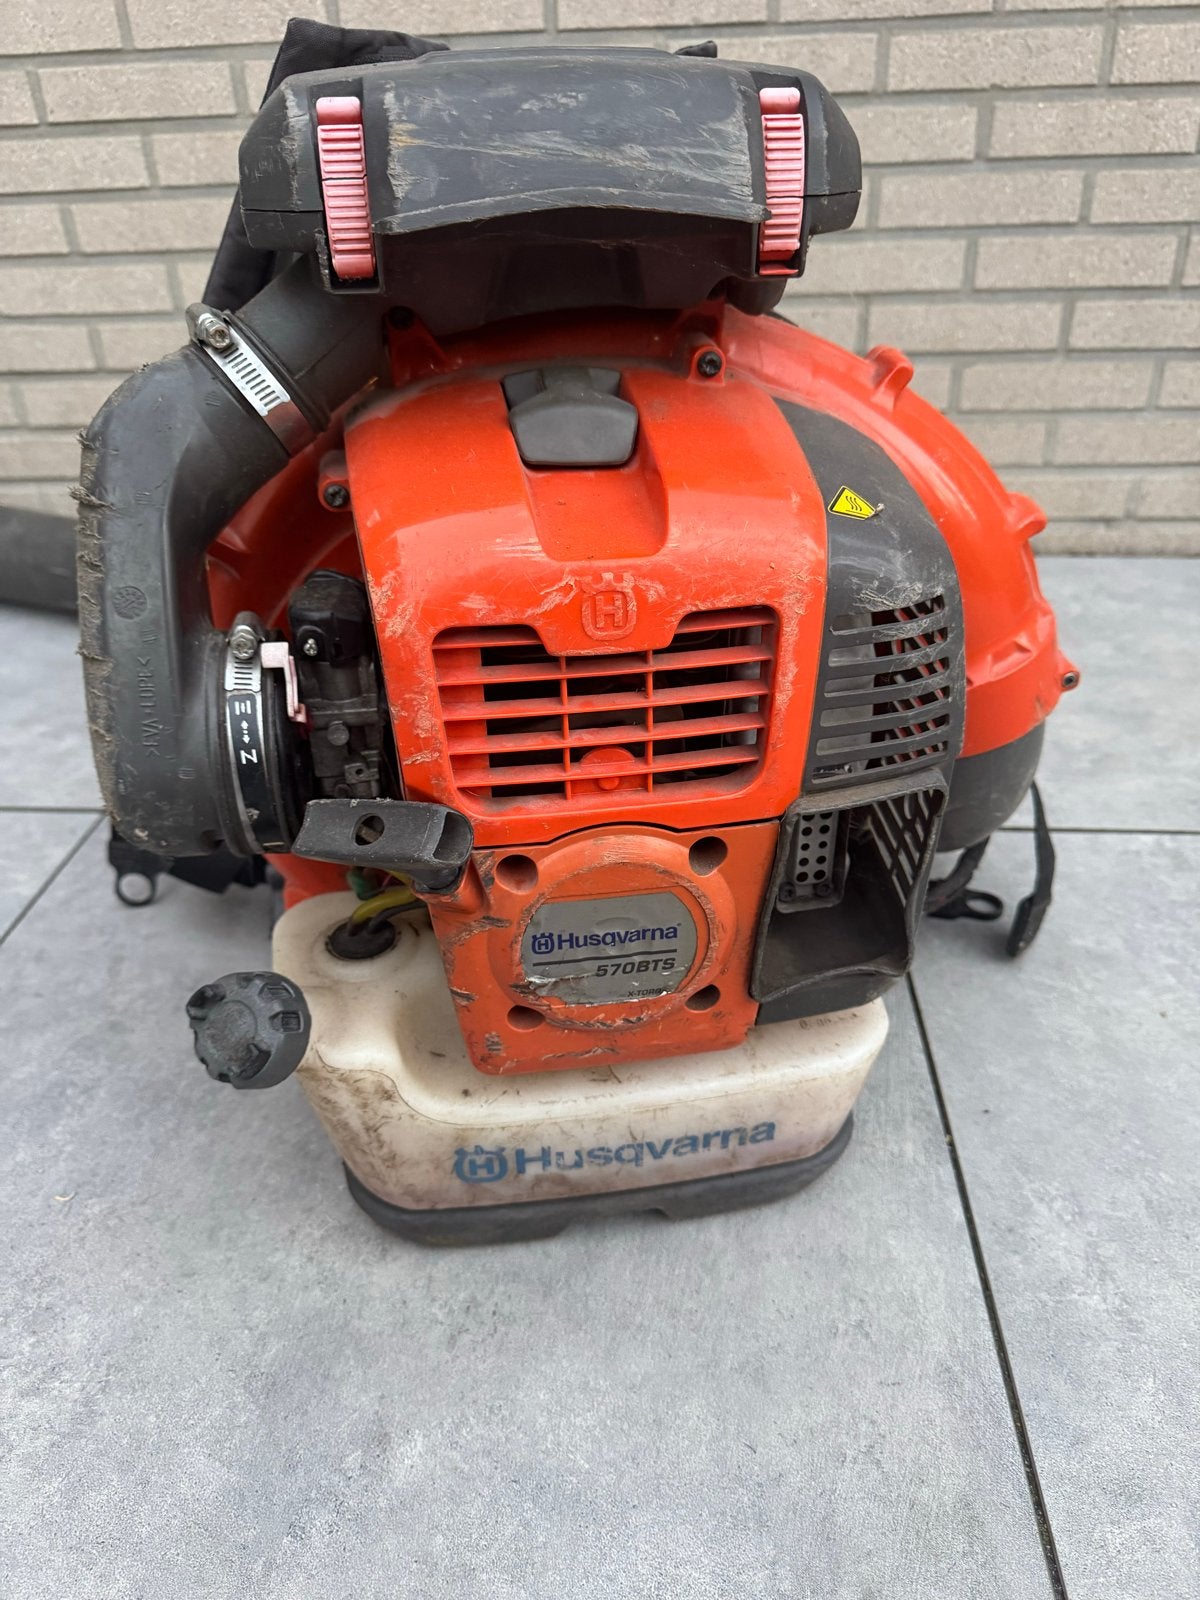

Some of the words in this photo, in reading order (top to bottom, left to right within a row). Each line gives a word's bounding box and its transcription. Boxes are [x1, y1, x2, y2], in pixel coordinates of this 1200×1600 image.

[557, 925, 678, 951] Husqvarna
[595, 957, 677, 978] 570BTS
[515, 1120, 777, 1175] Husqvarna
